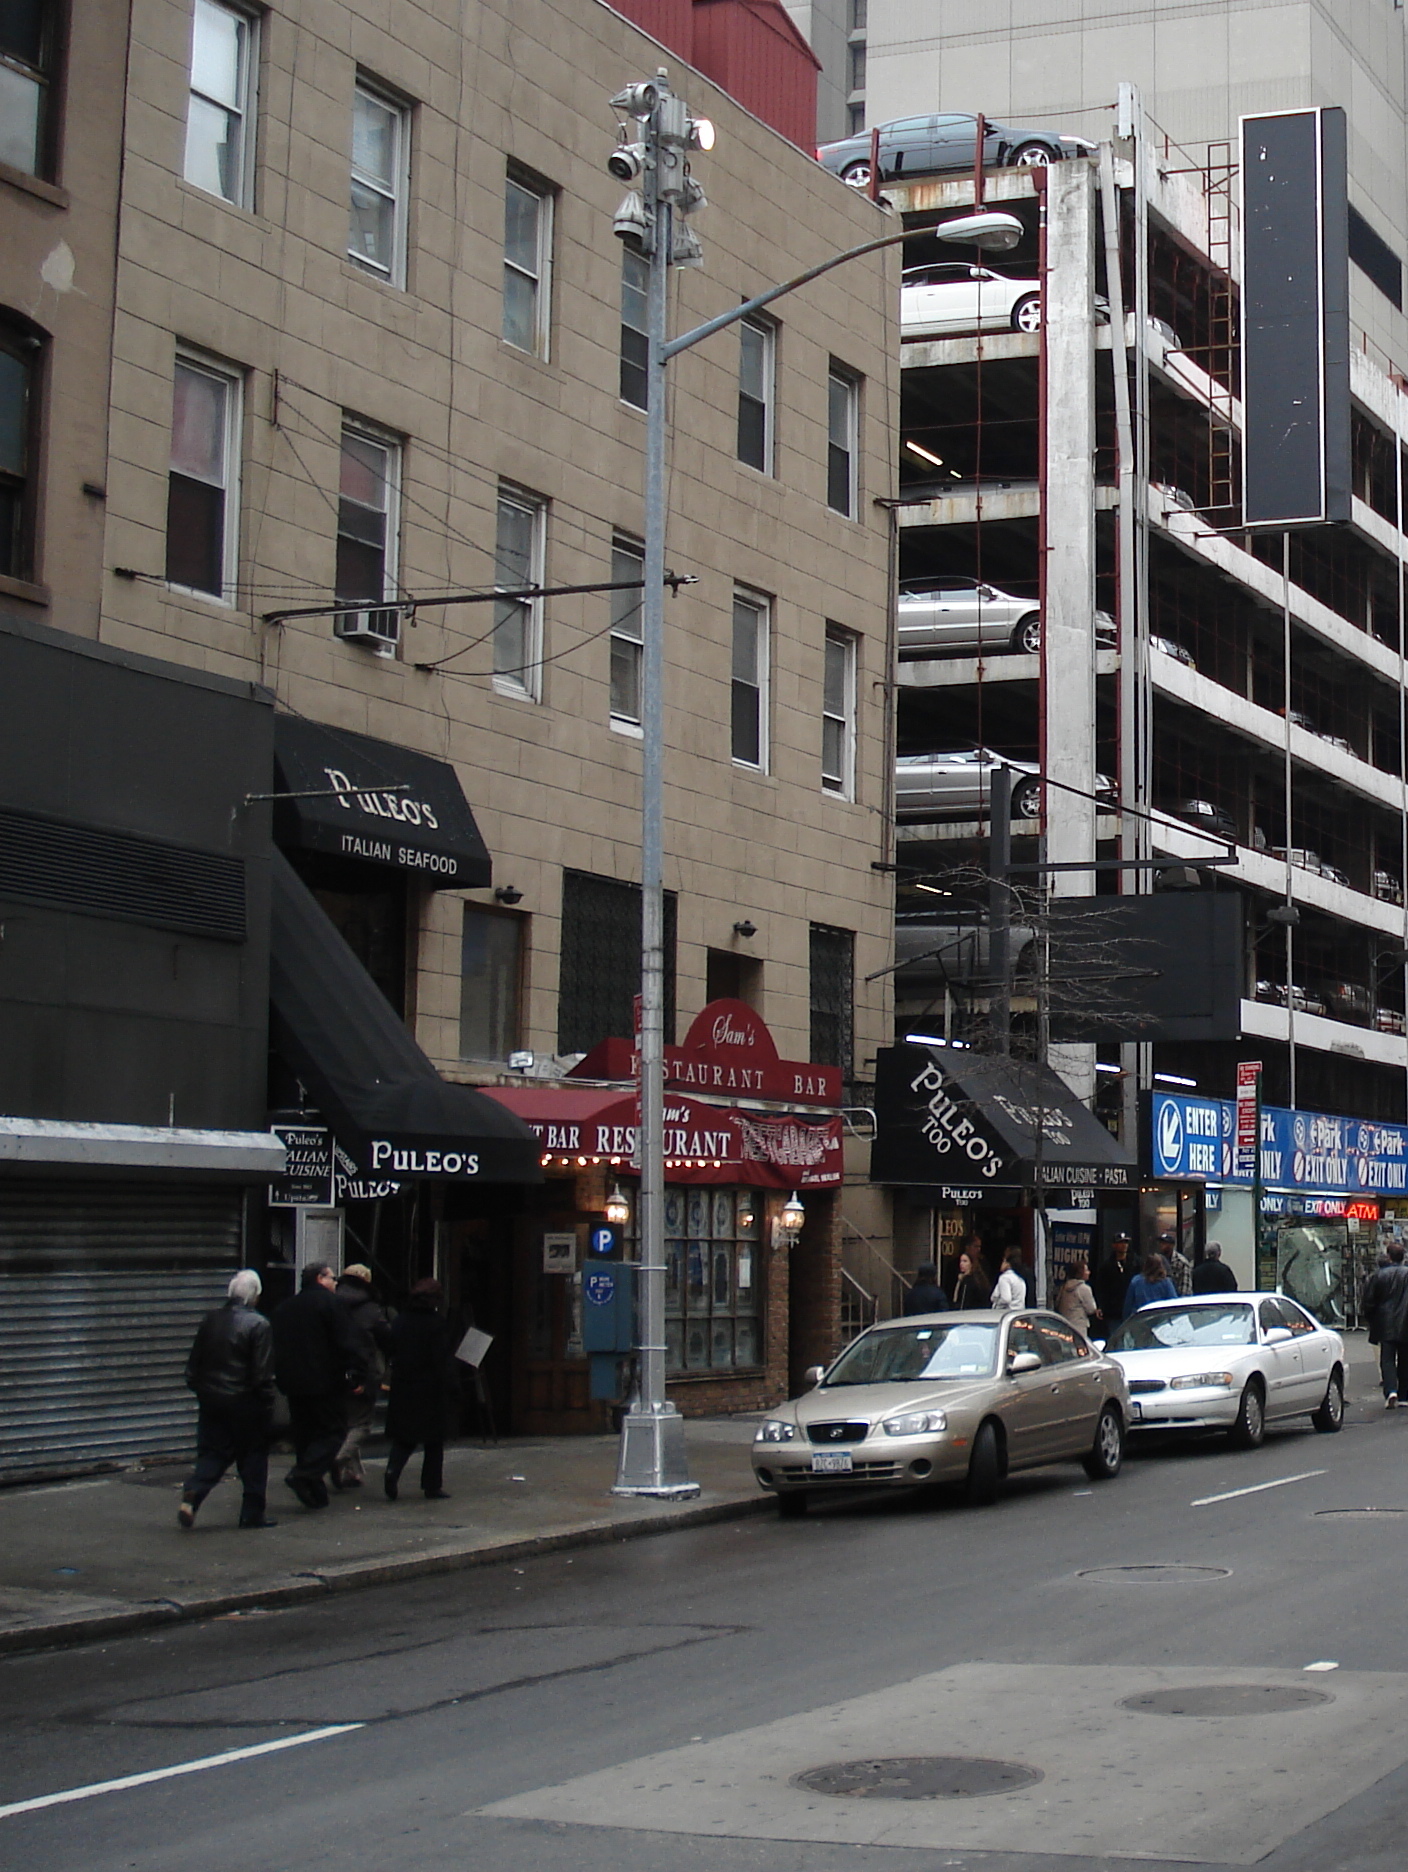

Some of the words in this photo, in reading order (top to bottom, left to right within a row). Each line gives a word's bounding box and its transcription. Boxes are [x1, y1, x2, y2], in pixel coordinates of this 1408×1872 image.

[341, 834, 392, 861] ITALIAN
[398, 846, 458, 875] SEAFOOD
[712, 1013, 756, 1049] Sam's
[630, 1055, 764, 1090] RSTAURANT
[794, 1074, 827, 1097] BAR
[921, 1115, 952, 1154] TOO
[1185, 1105, 1218, 1138] ENTER
[1260, 1113, 1276, 1143] rk
[1317, 1120, 1342, 1150] Park
[285, 1131, 323, 1147] Puleo's
[547, 1126, 580, 1149] BAR
[596, 1125, 732, 1158] RESURANT
[1381, 1129, 1404, 1156] Park
[284, 1149, 330, 1164] ALIAN
[1188, 1142, 1216, 1173] HERE
[1305, 1154, 1324, 1184] EXIT
[1326, 1157, 1348, 1185] ONLY
[1066, 1167, 1098, 1186] CUISINE
[1104, 1168, 1128, 1185] PASTA
[1368, 1160, 1387, 1188] EXIT
[1388, 1162, 1407, 1189] ONLY
[1260, 1197, 1284, 1213] ONLY
[1304, 1200, 1323, 1214] EXIT
[1324, 1200, 1348, 1215] ONLY
[1348, 1203, 1378, 1220] ATM
[598, 1229, 612, 1252] P
[1053, 1248, 1089, 1264] NIGHTS
[590, 1276, 598, 1288] P
